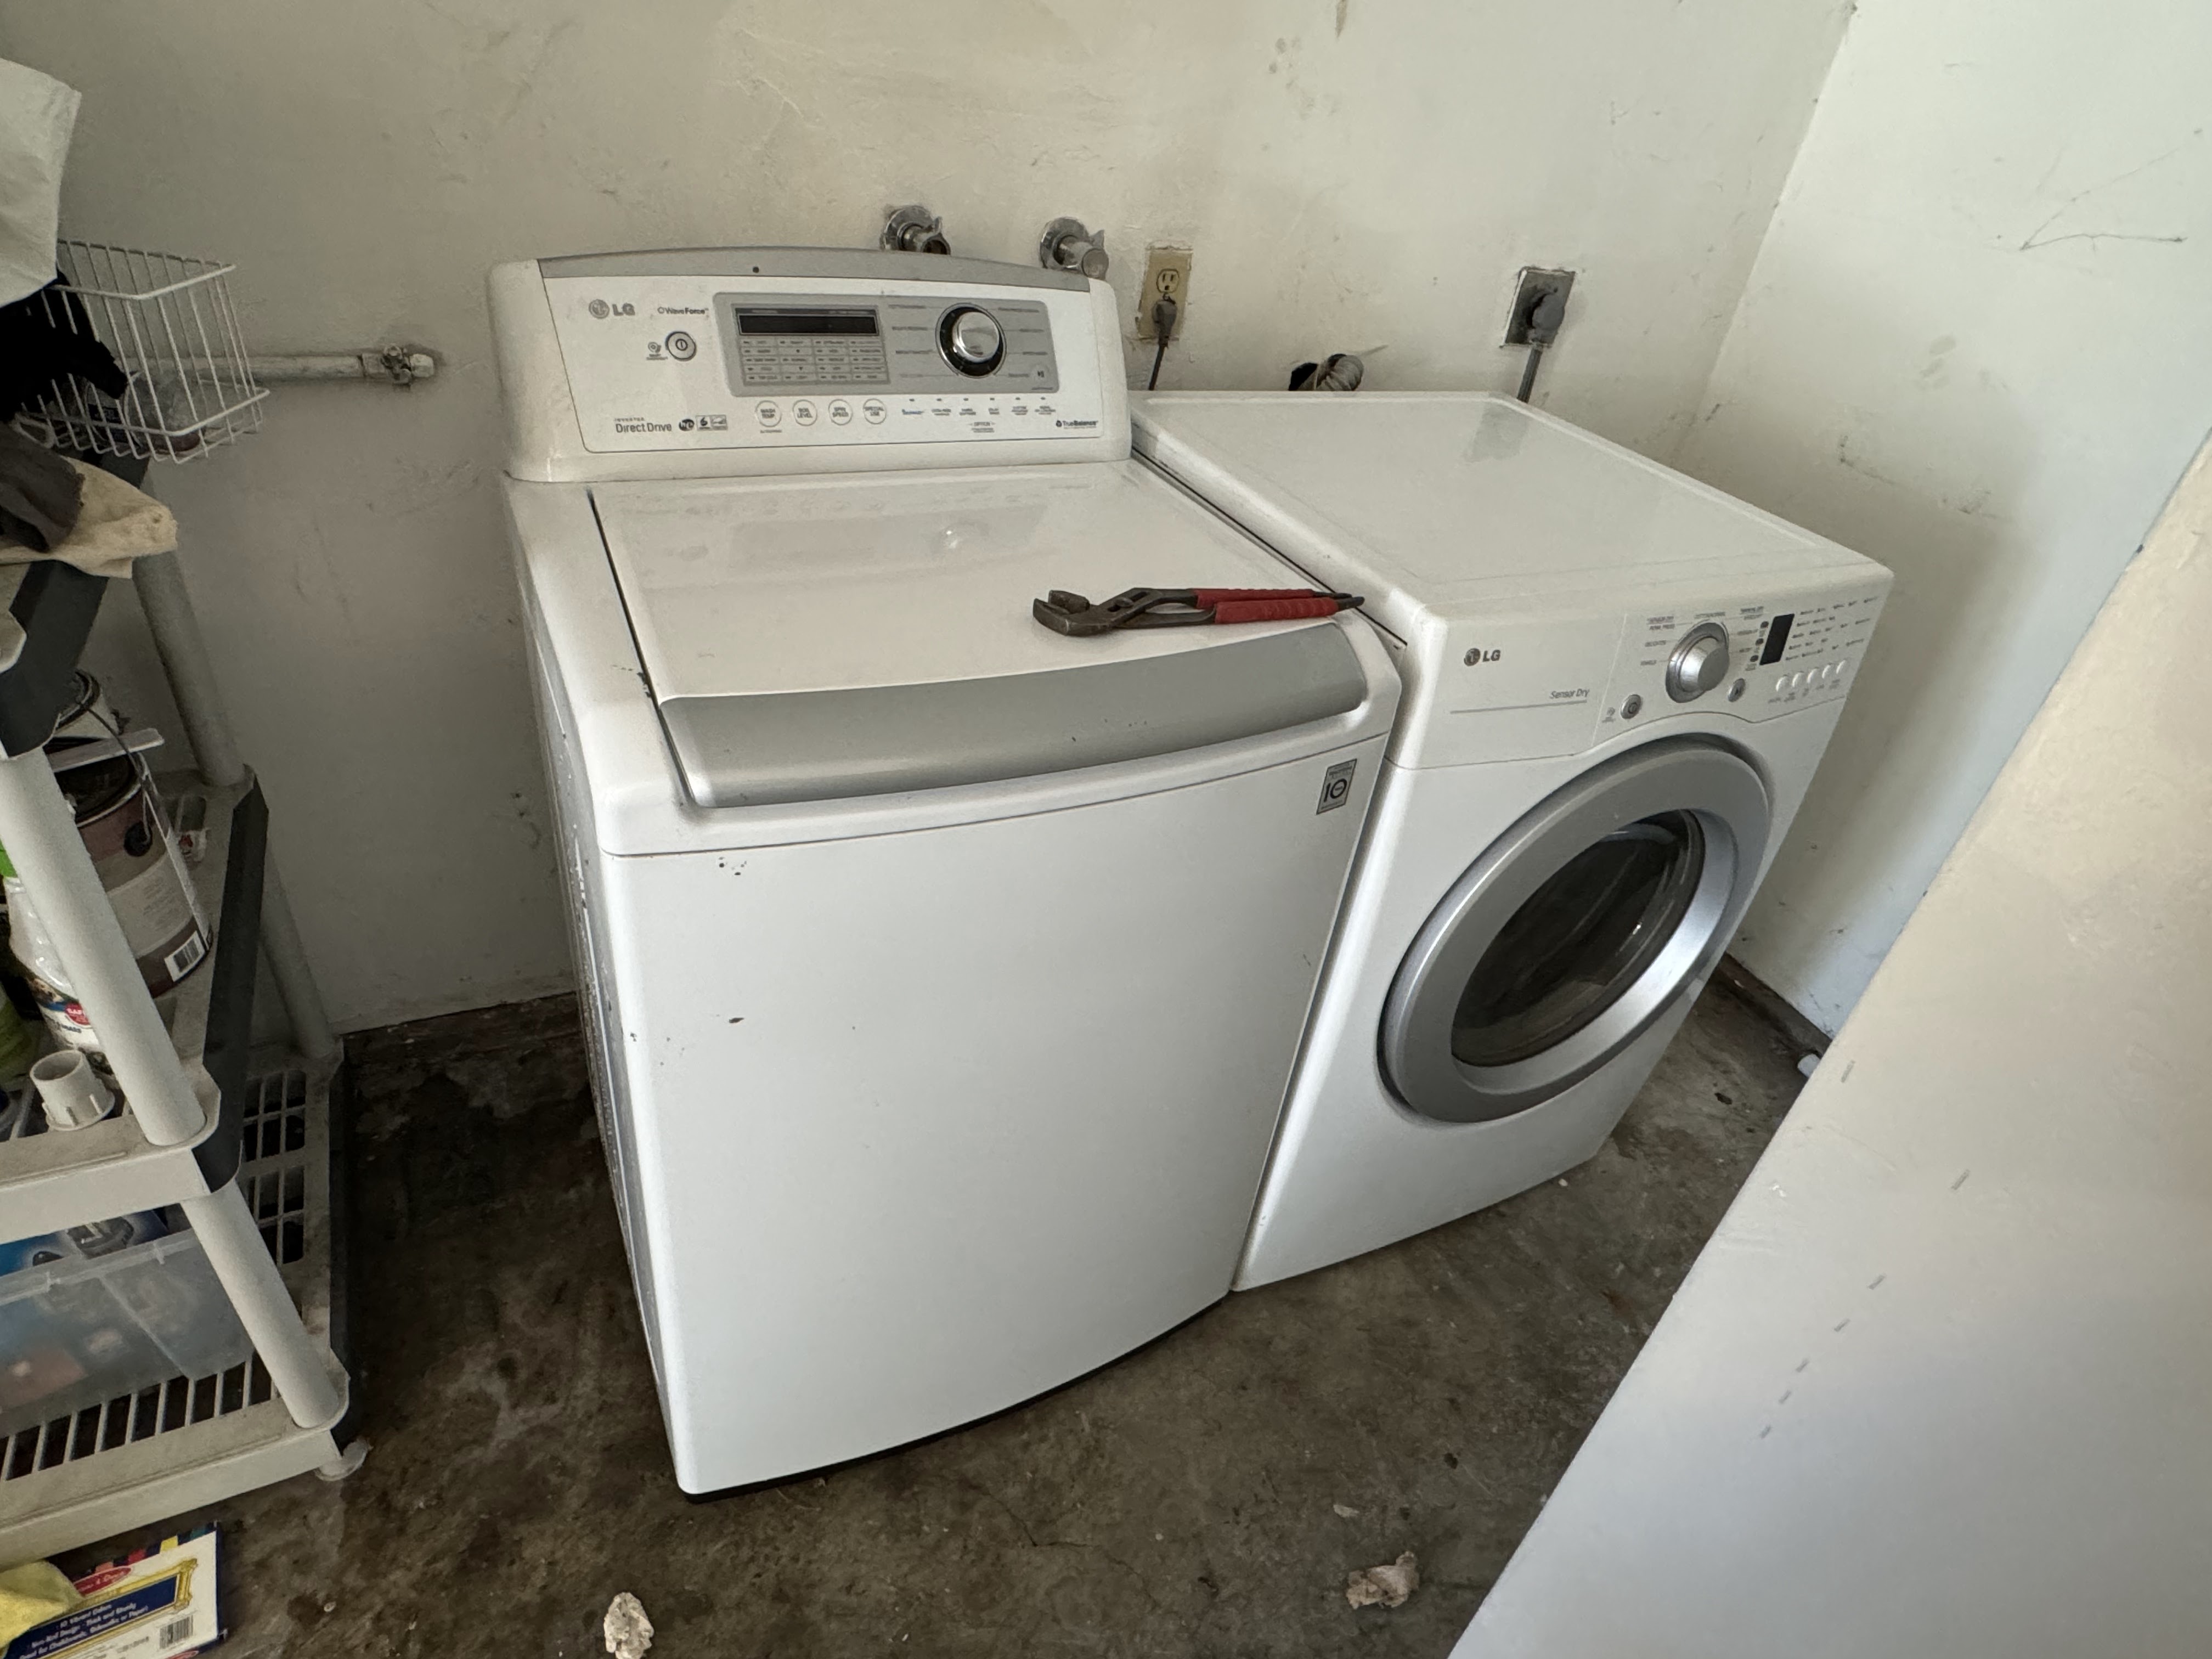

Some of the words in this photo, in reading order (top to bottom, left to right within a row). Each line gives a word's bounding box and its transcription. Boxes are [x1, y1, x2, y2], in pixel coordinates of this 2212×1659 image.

[612, 303, 635, 316] LG
[616, 423, 646, 433] Direct
[647, 422, 673, 432] Drive
[1482, 650, 1501, 663] LG
[1550, 690, 1575, 699] Sensor
[1576, 689, 1590, 697] Dry
